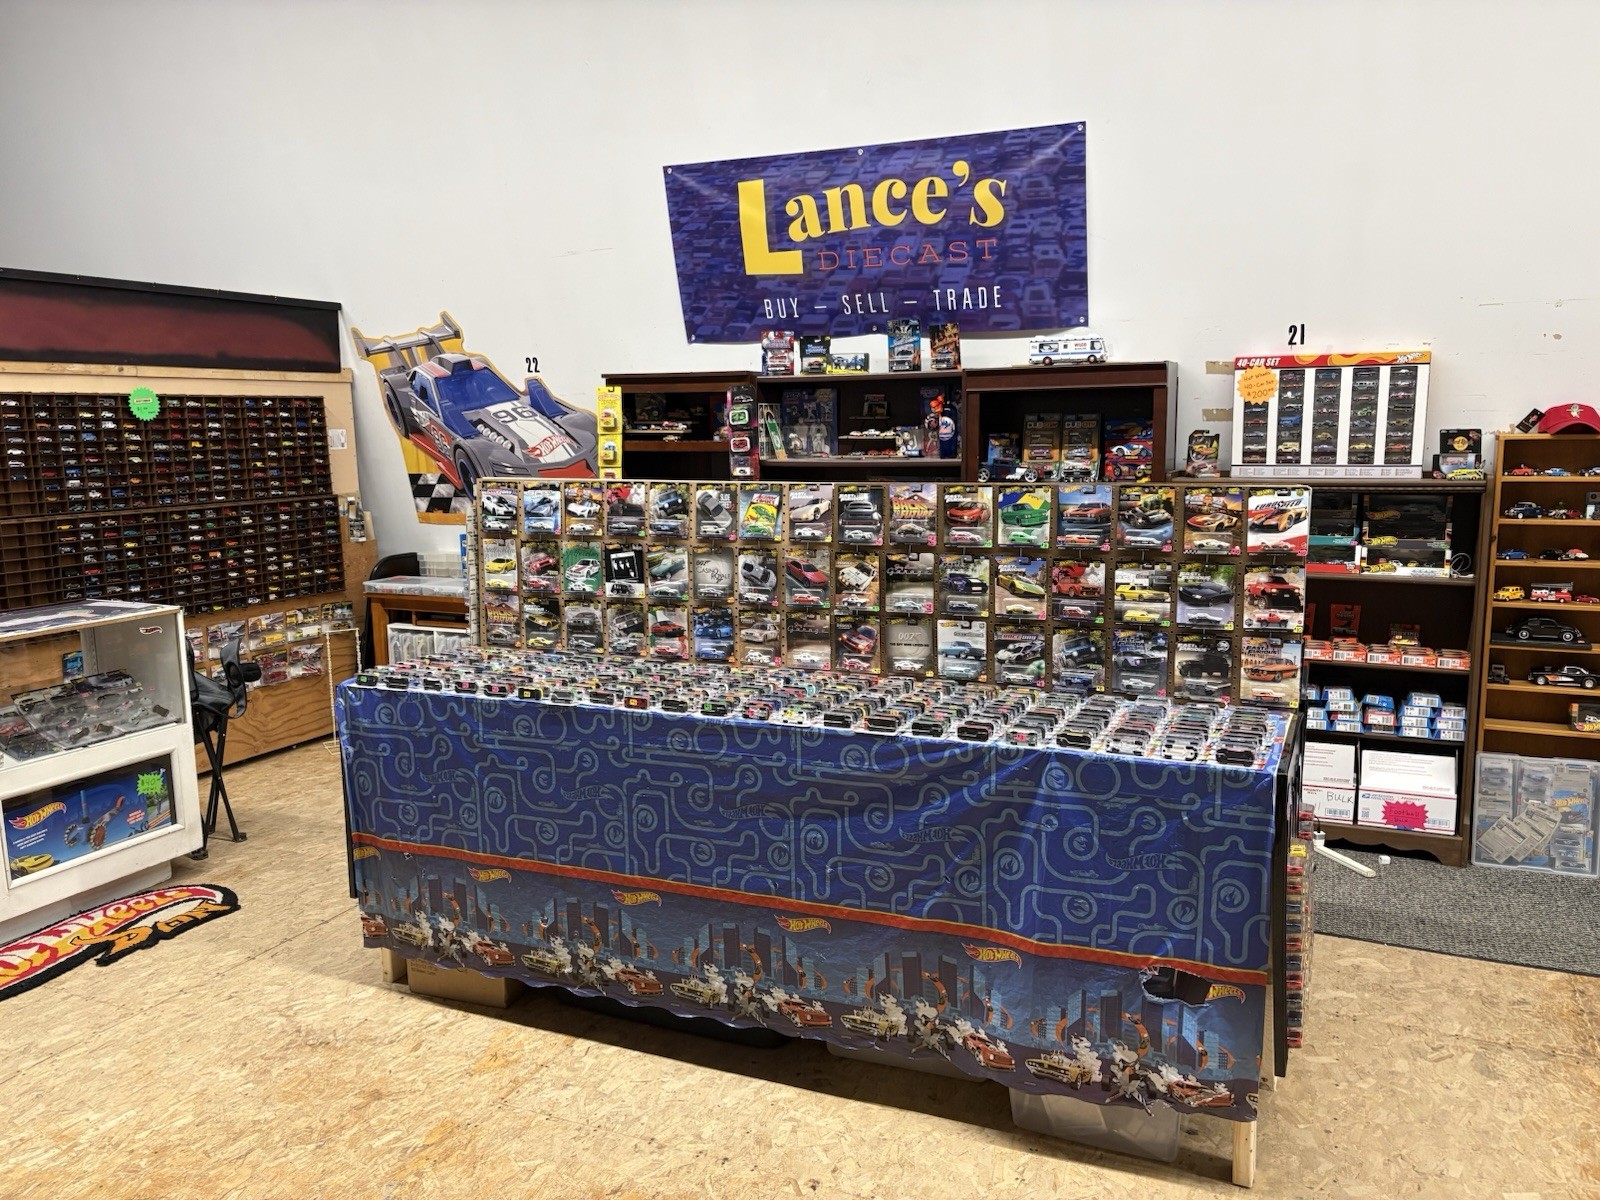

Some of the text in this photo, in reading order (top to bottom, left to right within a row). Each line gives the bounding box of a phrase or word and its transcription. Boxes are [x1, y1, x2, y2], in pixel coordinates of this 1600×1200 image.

[738, 160, 1007, 275] Lance's
[818, 238, 998, 270] DIECAST
[764, 286, 1002, 319] BUY SELL TRADE
[1288, 323, 1305, 345] 21
[525, 357, 540, 373] 22
[1237, 358, 1281, 367] 40-CAR SET
[1326, 791, 1354, 804] BULK
[26, 802, 65, 828] HOT WHEELS
[478, 869, 508, 881] HOT WHEELS
[625, 892, 658, 905] HOT WHEELS
[790, 919, 828, 931] HOT WHEELS
[980, 948, 1018, 962] HOT WHEELS
